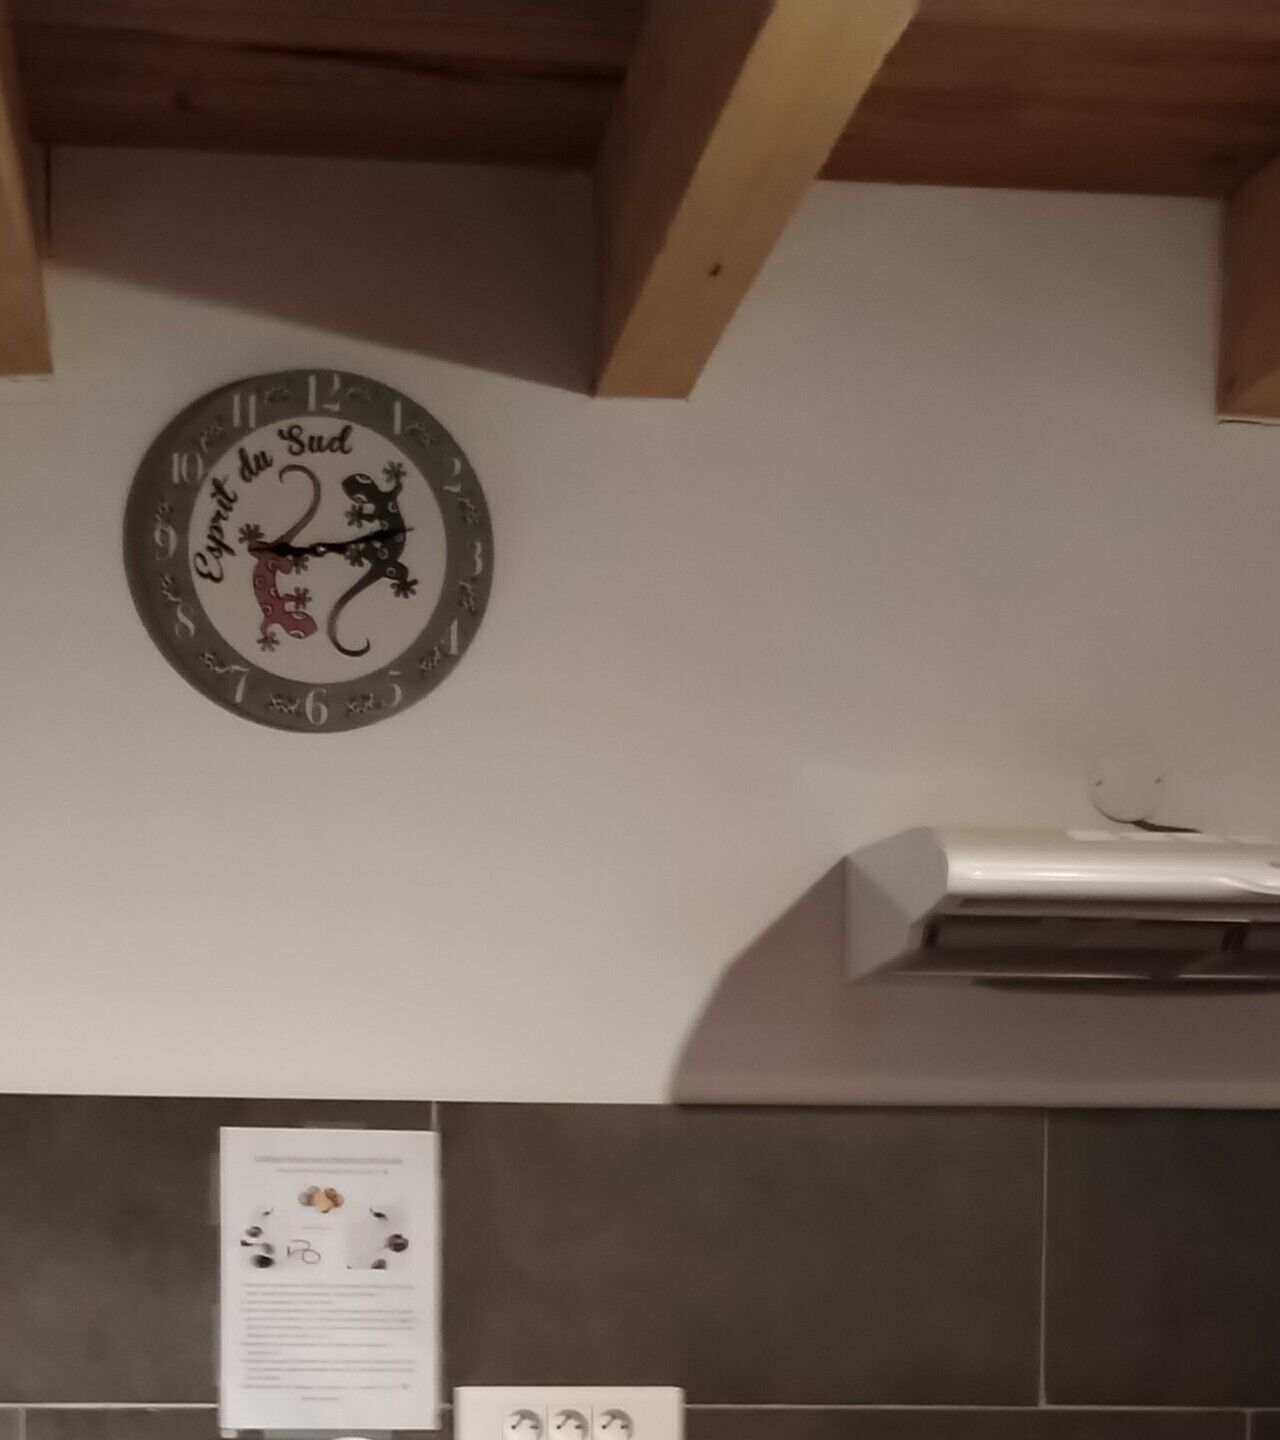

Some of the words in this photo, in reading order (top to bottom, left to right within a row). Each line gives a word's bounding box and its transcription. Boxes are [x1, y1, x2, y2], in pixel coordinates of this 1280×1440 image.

[232, 392, 257, 430] 11
[306, 373, 342, 412] 12
[392, 399, 403, 435] 1
[171, 450, 205, 486] 10
[194, 477, 238, 584] Esprit
[237, 448, 274, 483] du
[277, 423, 354, 457] Sud
[153, 524, 177, 562] 9
[466, 541, 485, 577] 3
[173, 603, 197, 640] 8
[229, 664, 251, 704] 7
[304, 688, 329, 727] 6
